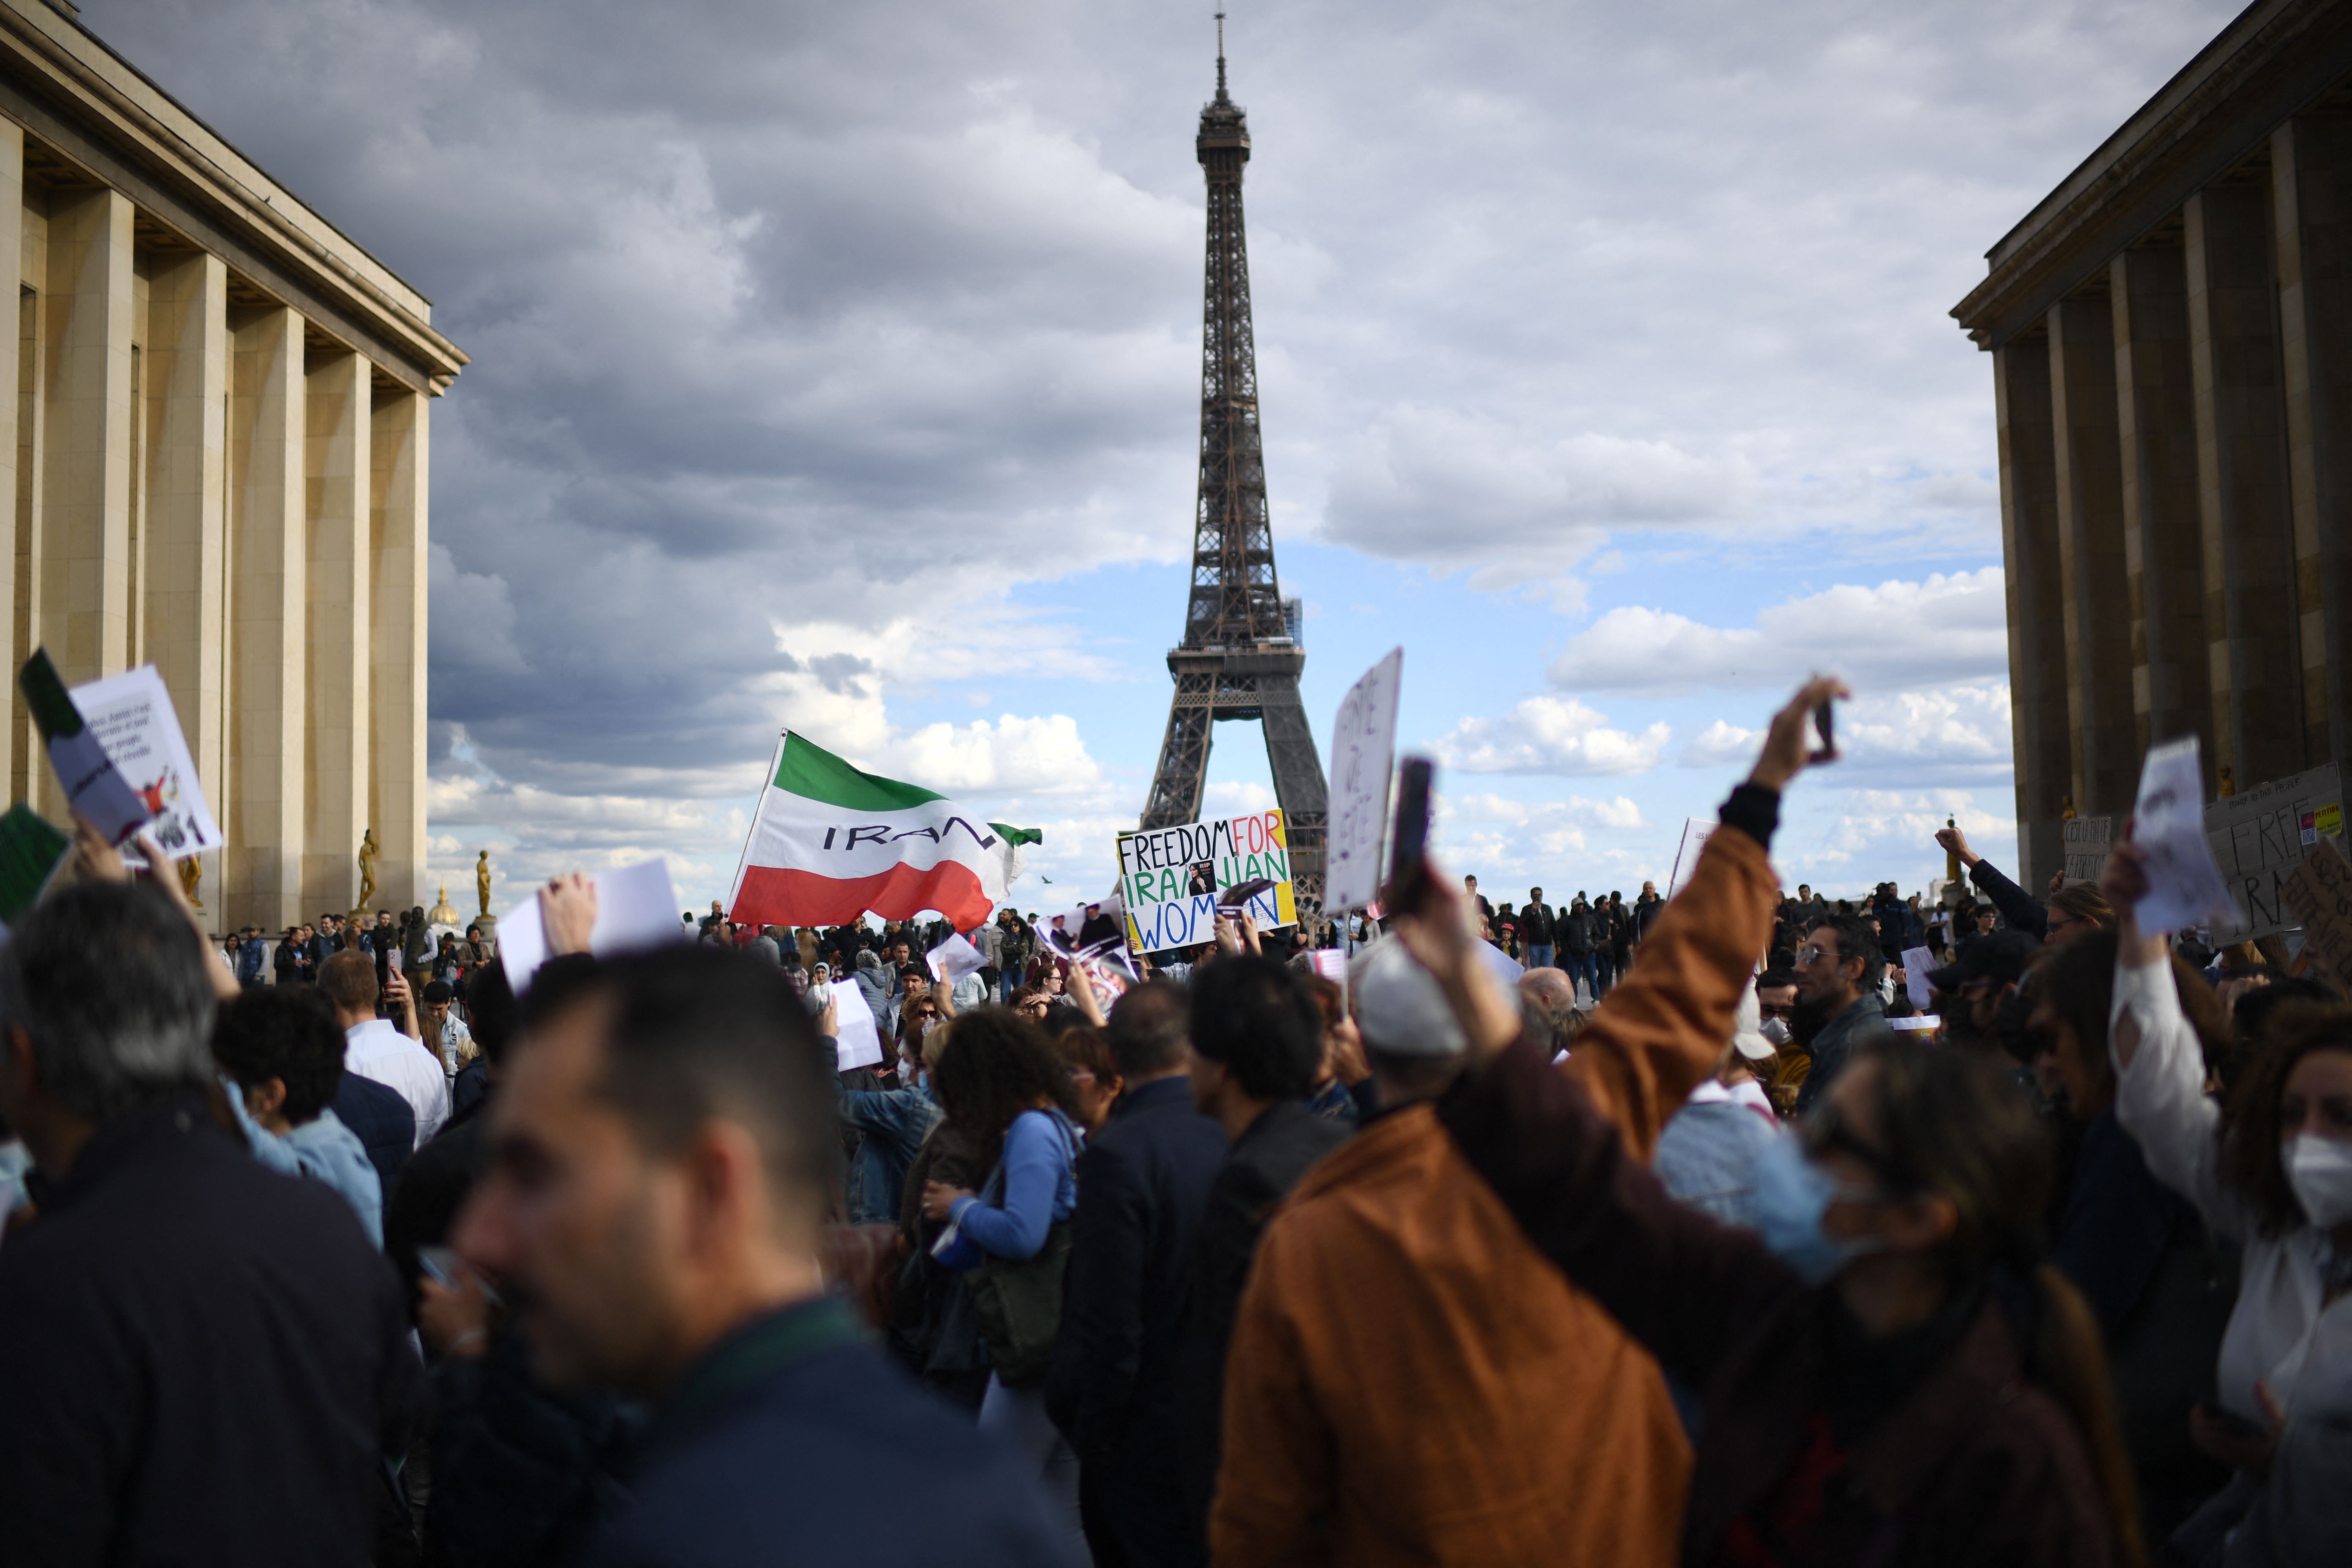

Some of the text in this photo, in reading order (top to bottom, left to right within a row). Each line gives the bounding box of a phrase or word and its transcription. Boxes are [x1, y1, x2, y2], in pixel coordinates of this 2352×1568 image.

[2229, 796, 2248, 809] POWER
[2259, 788, 2271, 799] THE
[2275, 778, 2300, 794] PEOPLE
[2315, 804, 2339, 819] PETITION
[824, 817, 996, 850] IRAN
[1118, 813, 1282, 874] FREEDOM FOR
[1132, 886, 1279, 950] WOMN
